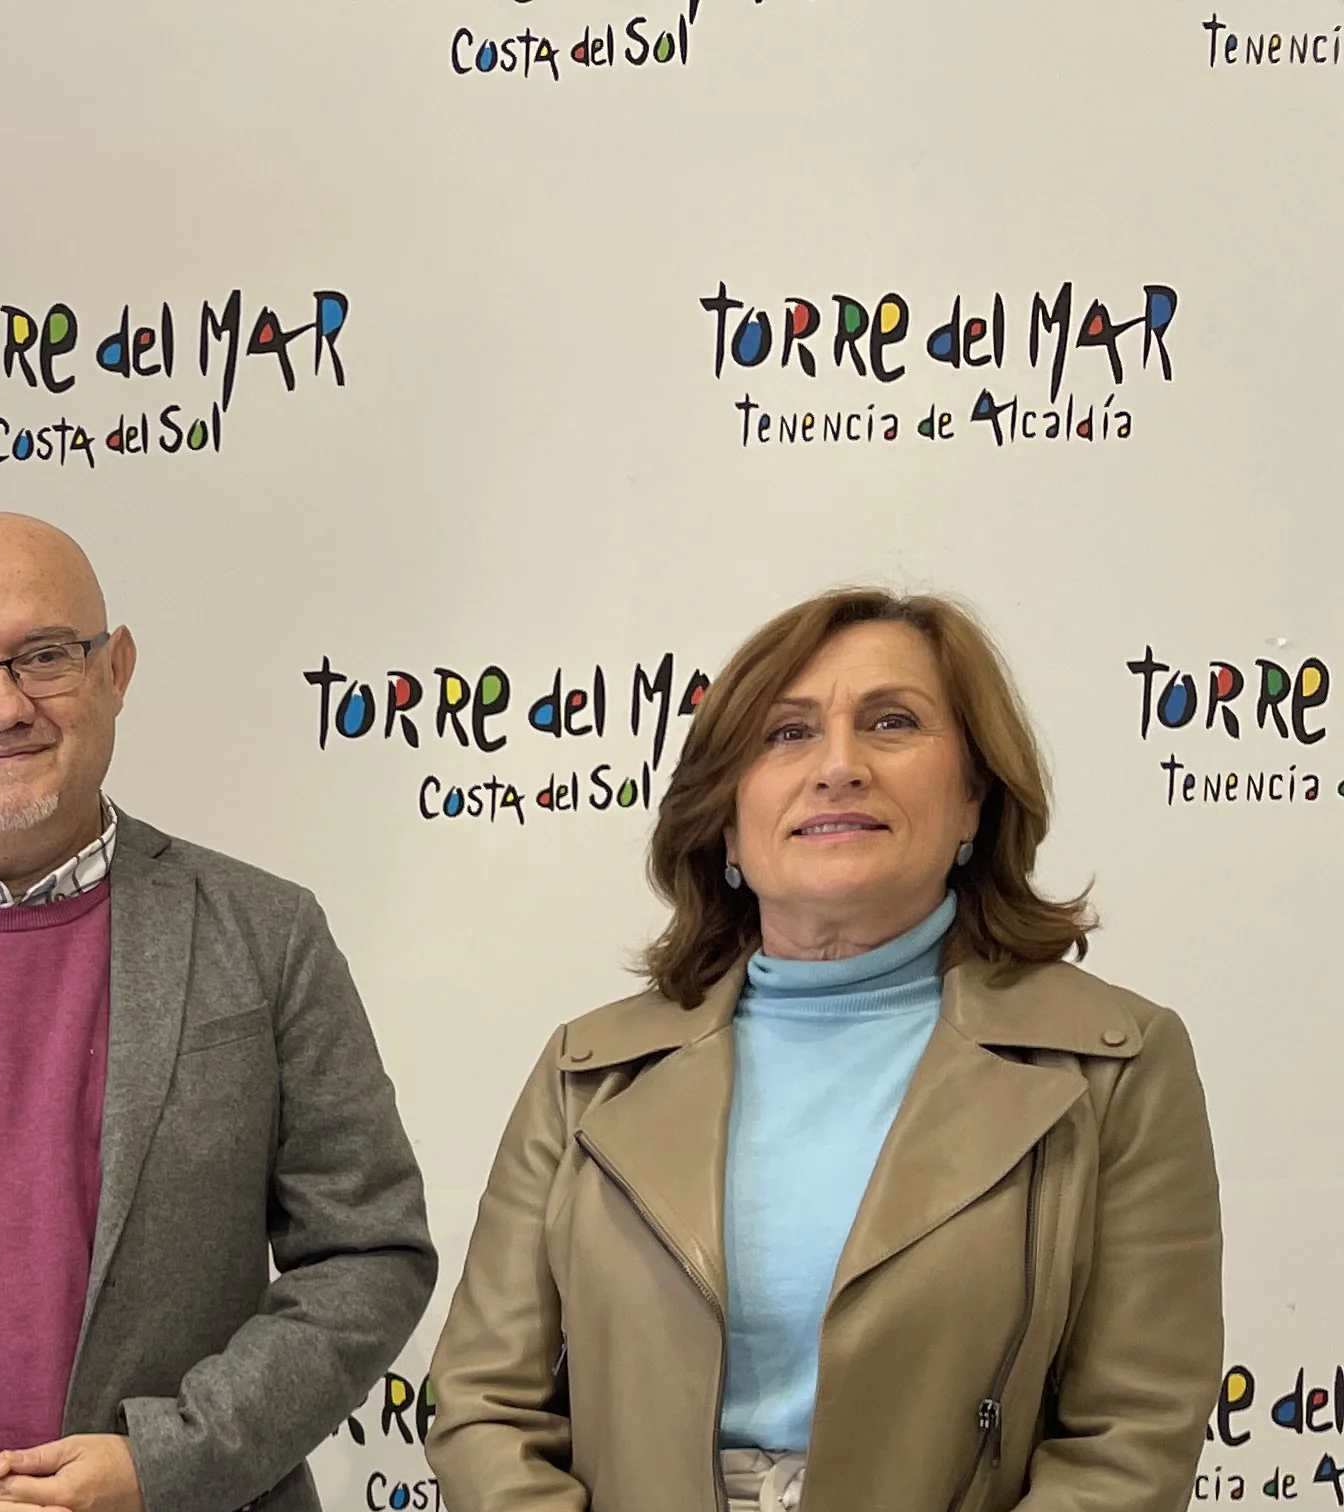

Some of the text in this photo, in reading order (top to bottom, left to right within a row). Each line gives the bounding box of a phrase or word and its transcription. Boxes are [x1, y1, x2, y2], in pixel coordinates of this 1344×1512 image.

[571, 24, 613, 66] del
[625, 14, 687, 65] Sol
[96, 302, 173, 378] del
[200, 290, 348, 412] MAR
[927, 293, 1004, 368] del
[1030, 282, 1177, 407] MAR
[106, 413, 148, 454] del
[160, 402, 220, 453] Sol
[918, 405, 954, 440] de
[528, 665, 605, 738] del
[536, 772, 578, 811] del
[590, 762, 650, 810] Sol
